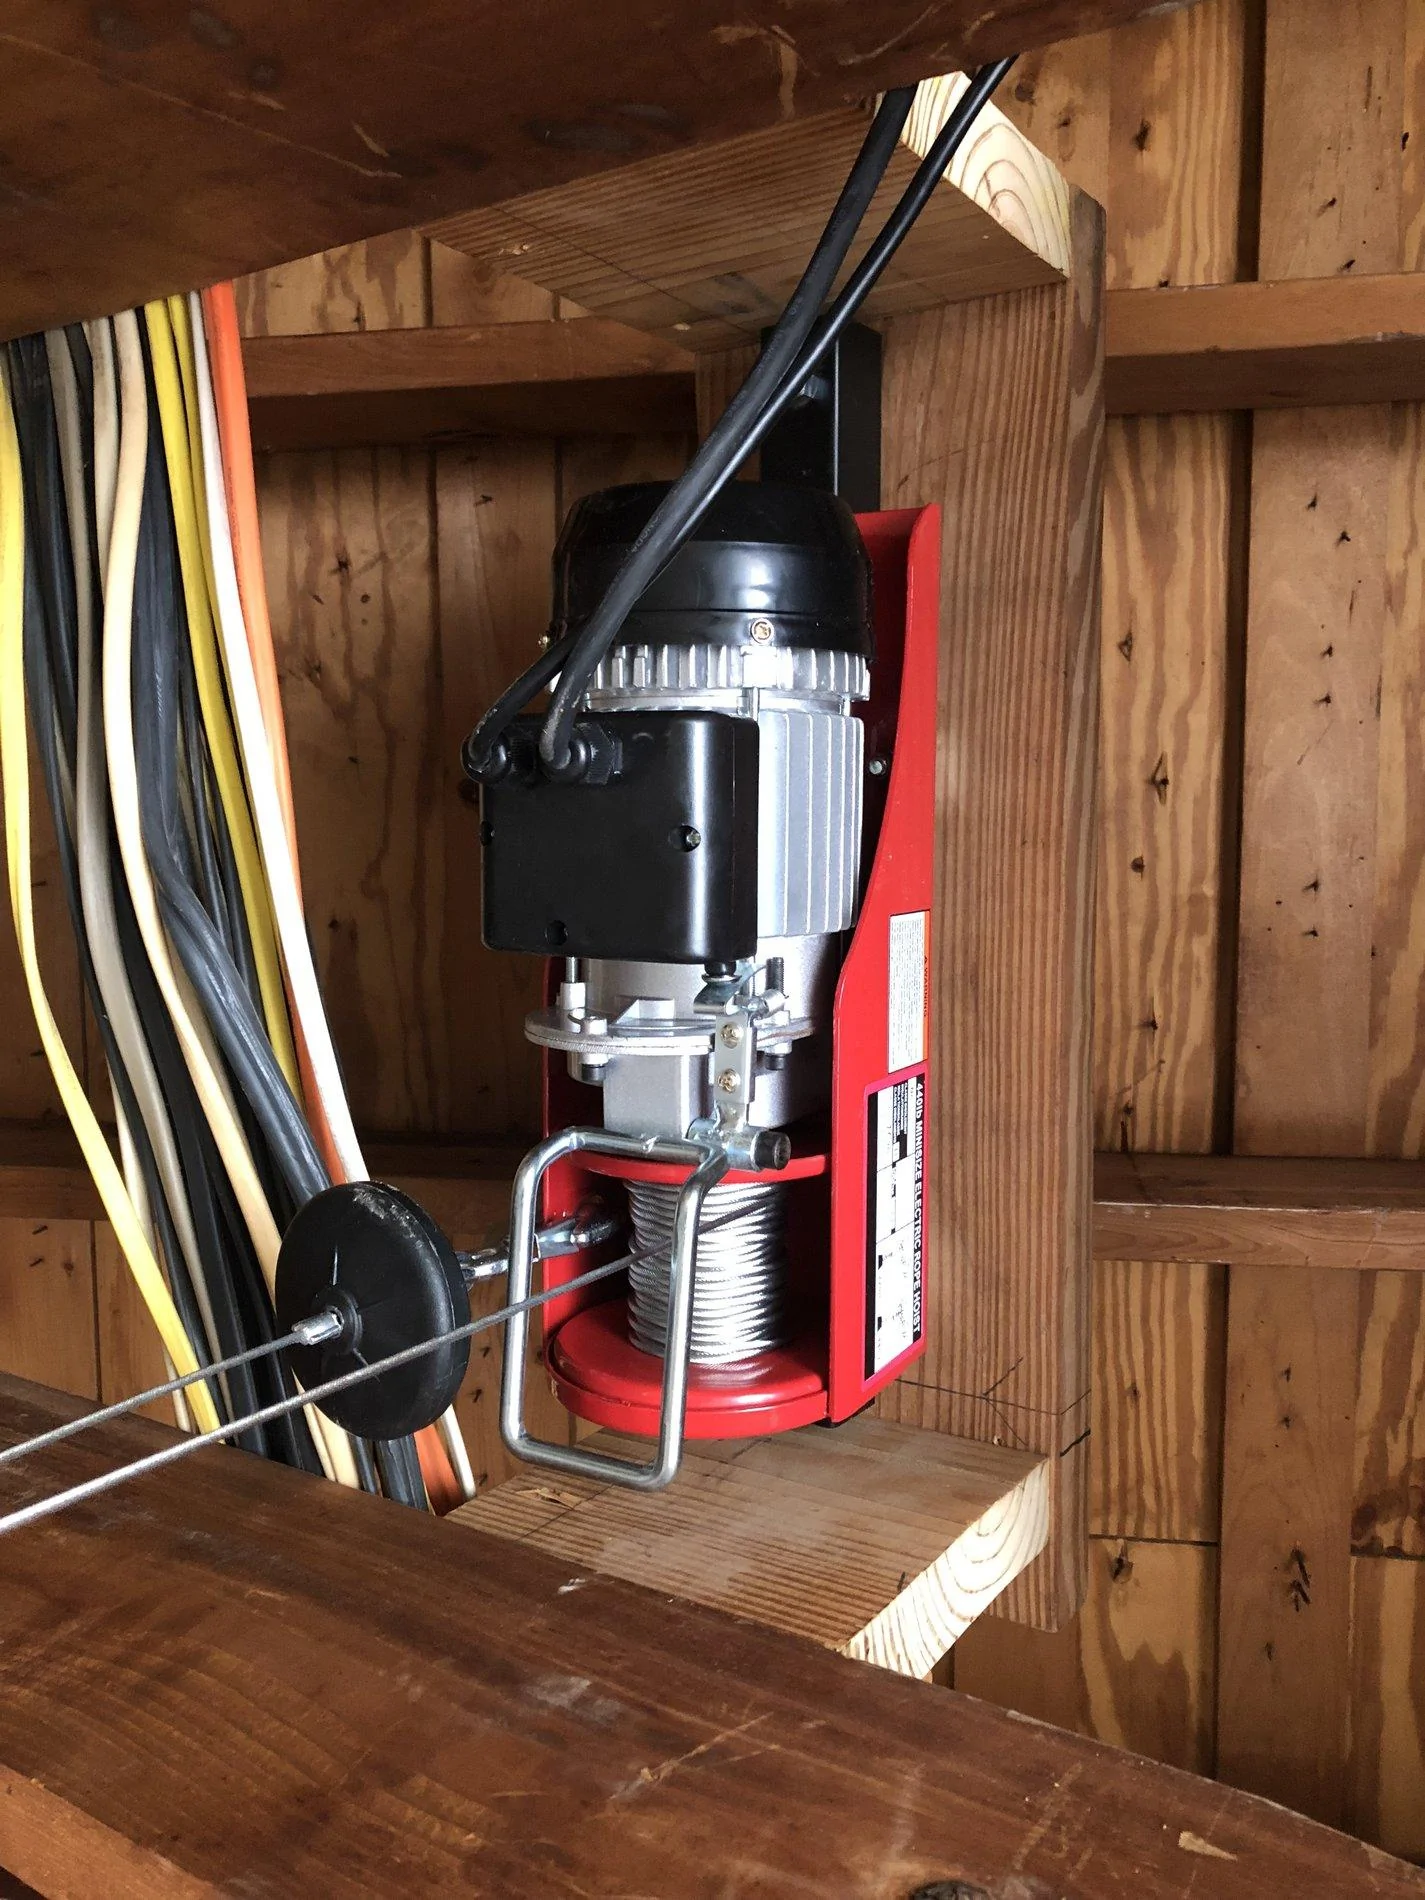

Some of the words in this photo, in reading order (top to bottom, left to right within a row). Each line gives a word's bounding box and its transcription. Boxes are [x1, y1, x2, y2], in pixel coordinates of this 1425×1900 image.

[916, 1083, 924, 1118] 440lb
[915, 1121, 923, 1180] MINISIZE
[914, 1182, 922, 1249] ELECTRIC
[913, 1251, 921, 1290] ROPE
[913, 1292, 921, 1333] HOIST
